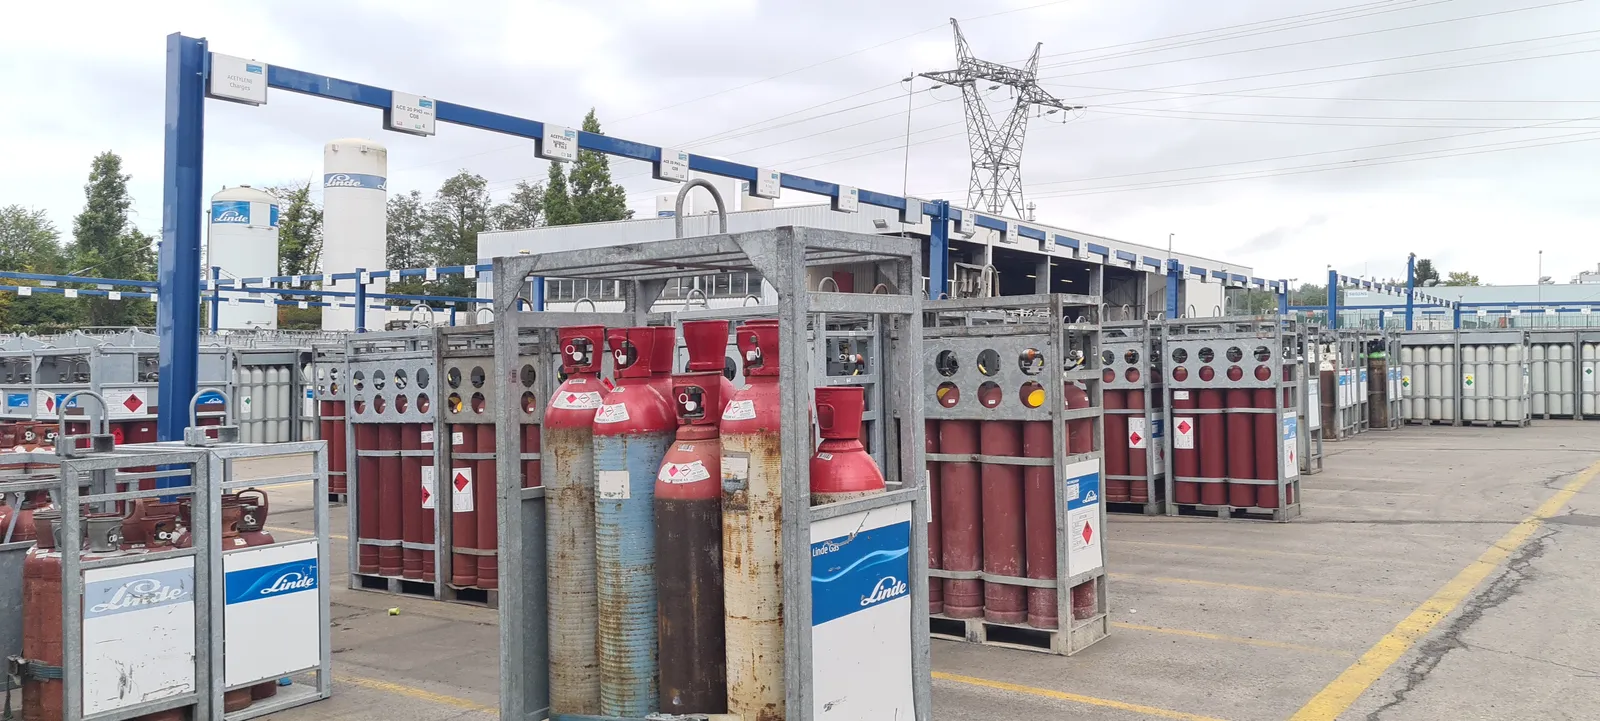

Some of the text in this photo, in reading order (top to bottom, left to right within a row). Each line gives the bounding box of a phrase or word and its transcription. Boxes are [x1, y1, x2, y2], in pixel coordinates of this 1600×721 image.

[229, 82, 251, 91] Charges
[325, 173, 365, 189] Linde
[214, 210, 249, 222] Linde
[812, 543, 840, 557] Linde Gas
[260, 572, 315, 595] Linde
[860, 576, 907, 606] Linde
[90, 578, 188, 613] Linde
